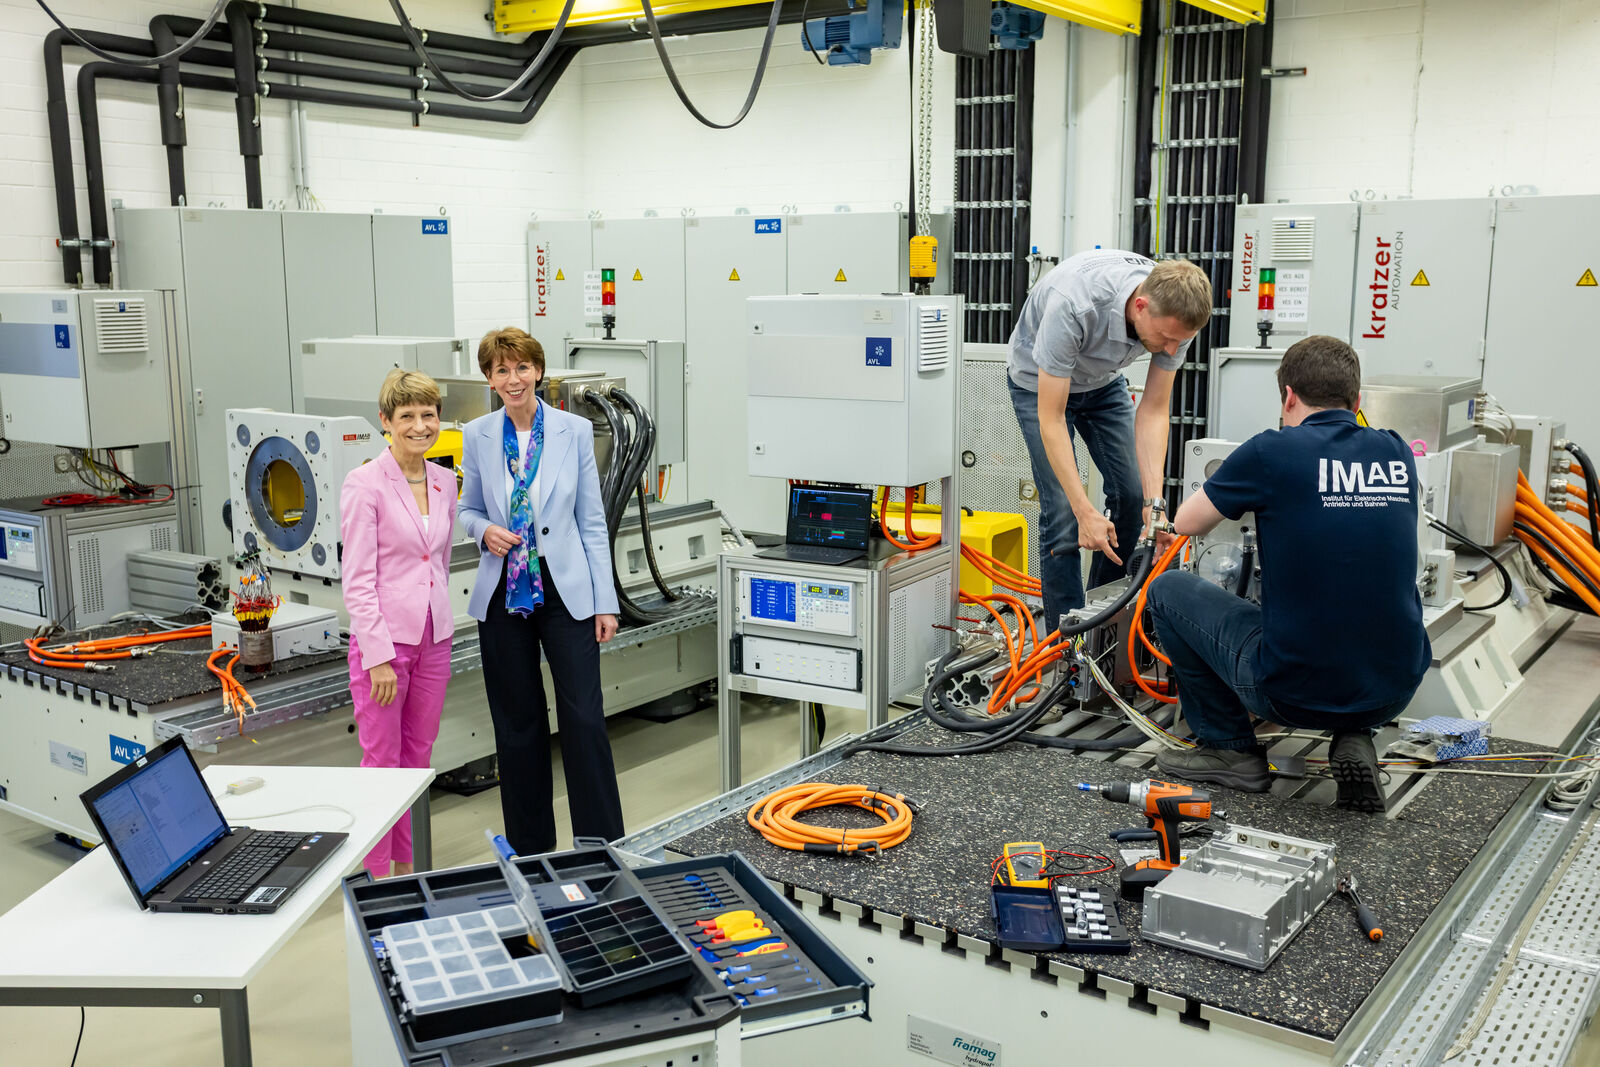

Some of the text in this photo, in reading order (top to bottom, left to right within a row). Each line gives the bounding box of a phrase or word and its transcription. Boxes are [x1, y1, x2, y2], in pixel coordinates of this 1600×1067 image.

[535, 245, 546, 317] kratzer
[1238, 233, 1253, 292] kratzer
[1362, 236, 1391, 339] kratzer
[1392, 231, 1403, 310] AUTOMATION
[1318, 458, 1409, 493] IMAB
[114, 745, 131, 760] AVL
